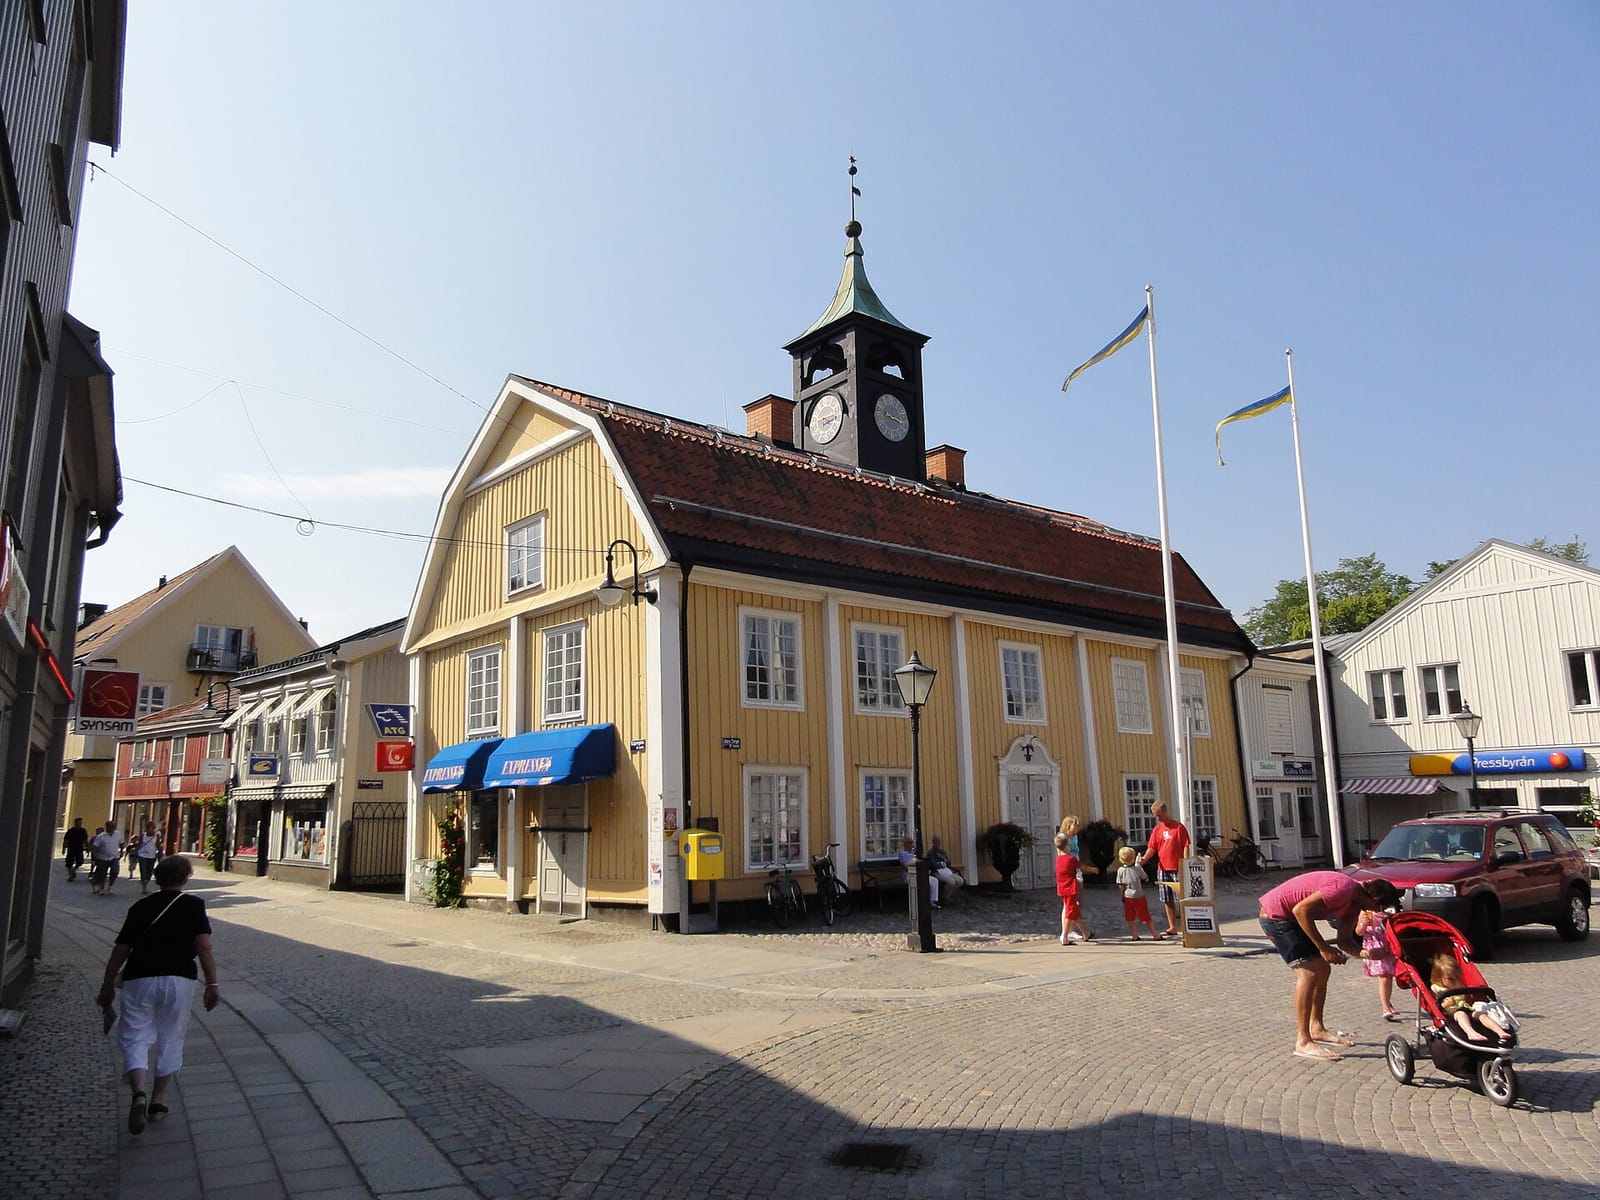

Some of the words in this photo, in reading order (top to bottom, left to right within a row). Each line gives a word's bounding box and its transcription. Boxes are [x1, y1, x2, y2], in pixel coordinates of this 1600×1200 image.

[80, 720, 134, 732] SYNSAM
[384, 726, 406, 735] ATG
[1473, 756, 1536, 770] Pressbyrån
